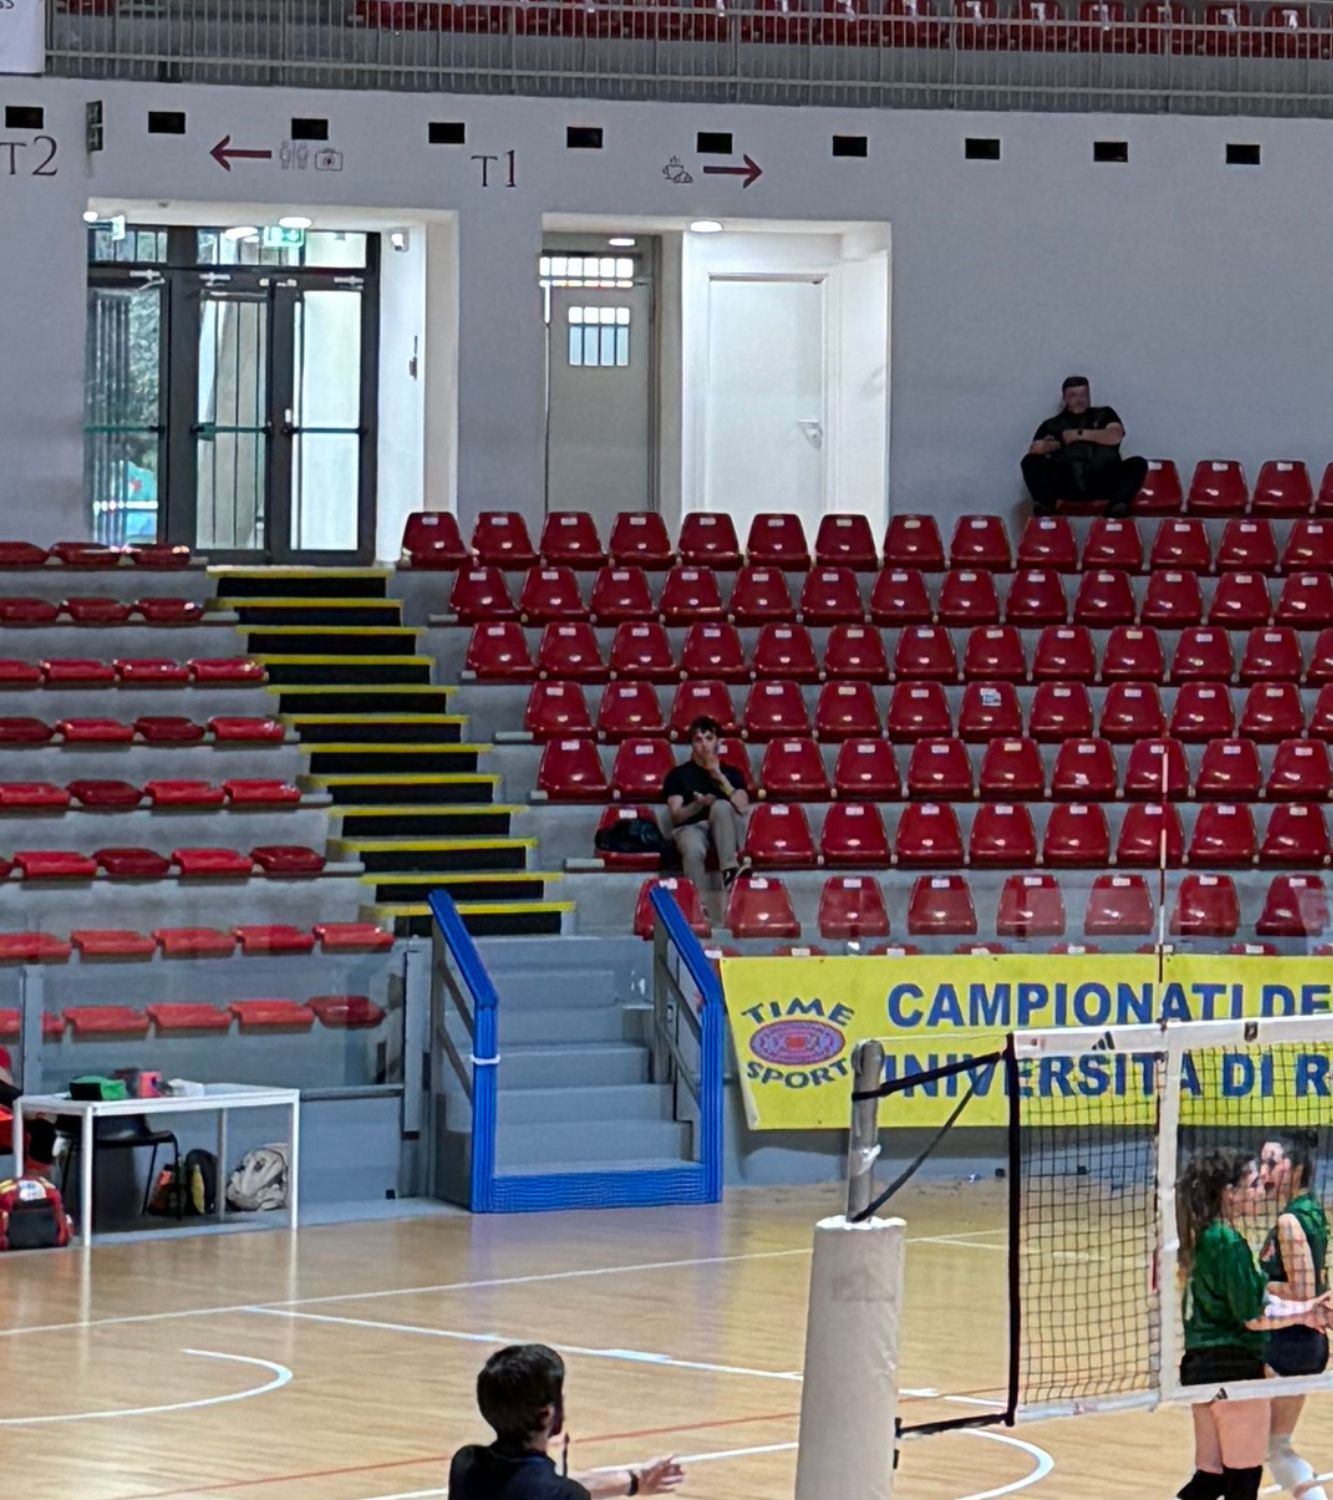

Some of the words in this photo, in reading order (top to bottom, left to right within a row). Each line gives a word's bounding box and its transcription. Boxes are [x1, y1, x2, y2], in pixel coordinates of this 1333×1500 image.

[0, 135, 58, 176] T2
[470, 149, 517, 188] T1
[741, 998, 855, 1026] TIME
[887, 982, 1244, 1028] CAMPIONATI
[746, 1057, 848, 1089] SPORT
[1221, 1053, 1274, 1098] DI
